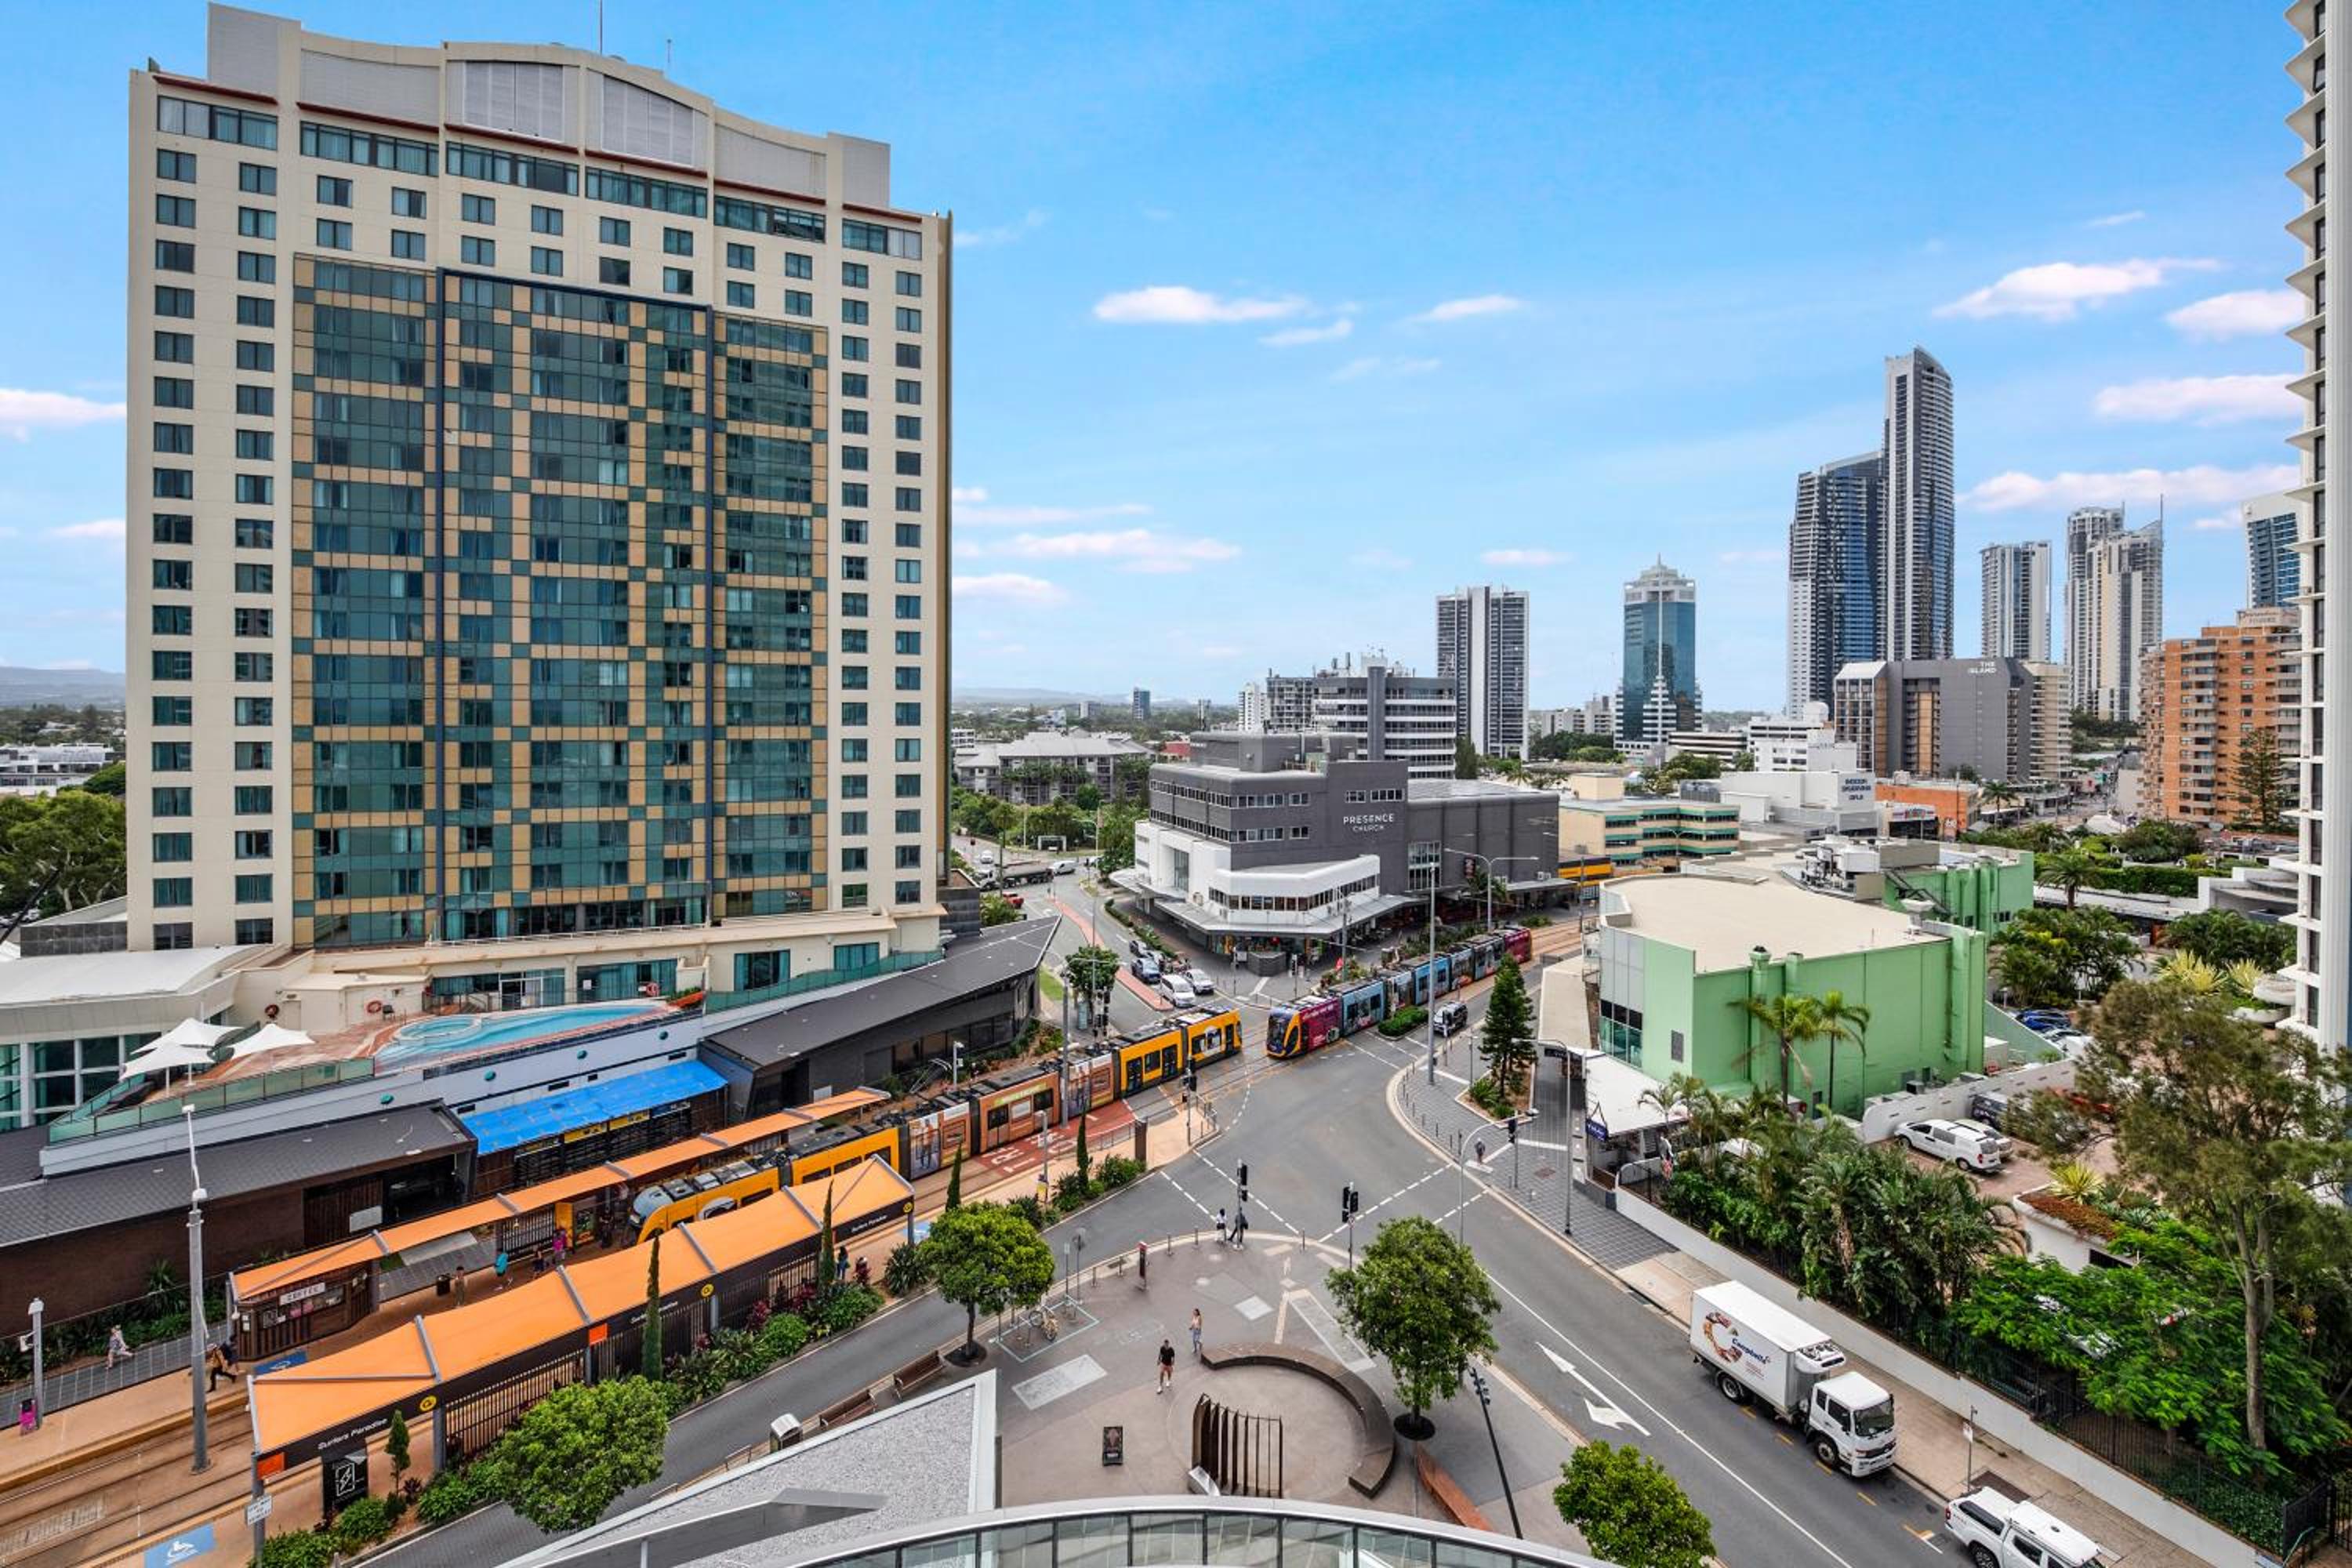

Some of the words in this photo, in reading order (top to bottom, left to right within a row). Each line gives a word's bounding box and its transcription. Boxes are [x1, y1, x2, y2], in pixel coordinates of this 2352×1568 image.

[1342, 813, 1395, 825] PRESENCE
[317, 1432, 350, 1450] Surfers
[350, 1417, 389, 1438] Paradise
